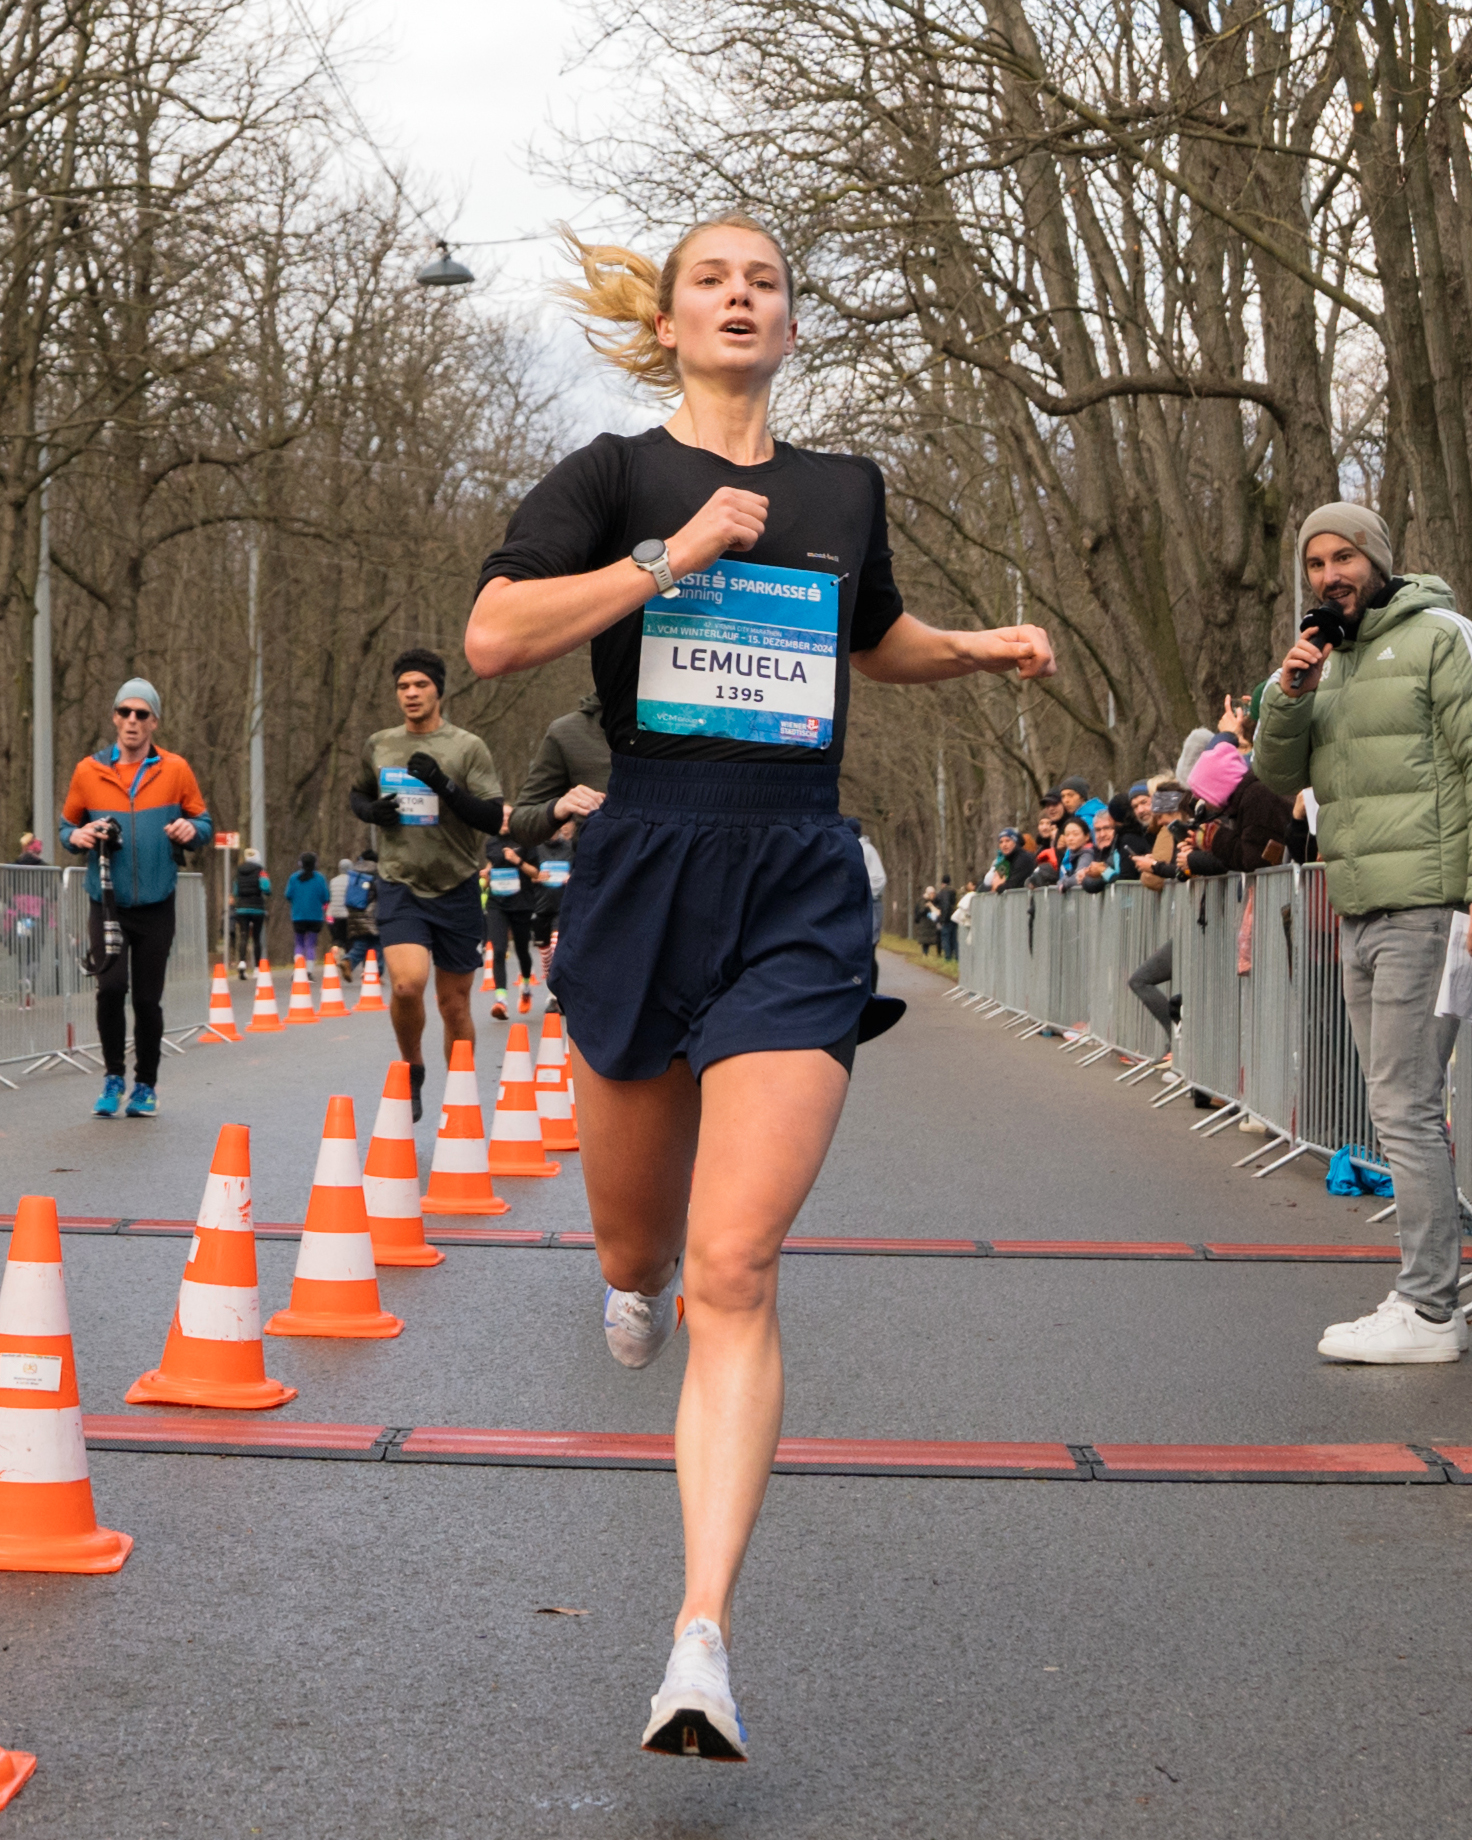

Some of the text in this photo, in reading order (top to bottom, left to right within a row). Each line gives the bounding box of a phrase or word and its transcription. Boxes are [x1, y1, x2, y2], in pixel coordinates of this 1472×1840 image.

[676, 587, 723, 605] unning
[730, 577, 807, 600] SPARKASSE
[657, 625, 678, 634] VCM
[680, 627, 740, 640] WINTERLAUF
[747, 634, 761, 644] 15.
[762, 636, 811, 651] DEZEMBER
[811, 643, 834, 654] 2024
[672, 646, 807, 684] LEMUELA
[715, 685, 764, 703] 1395
